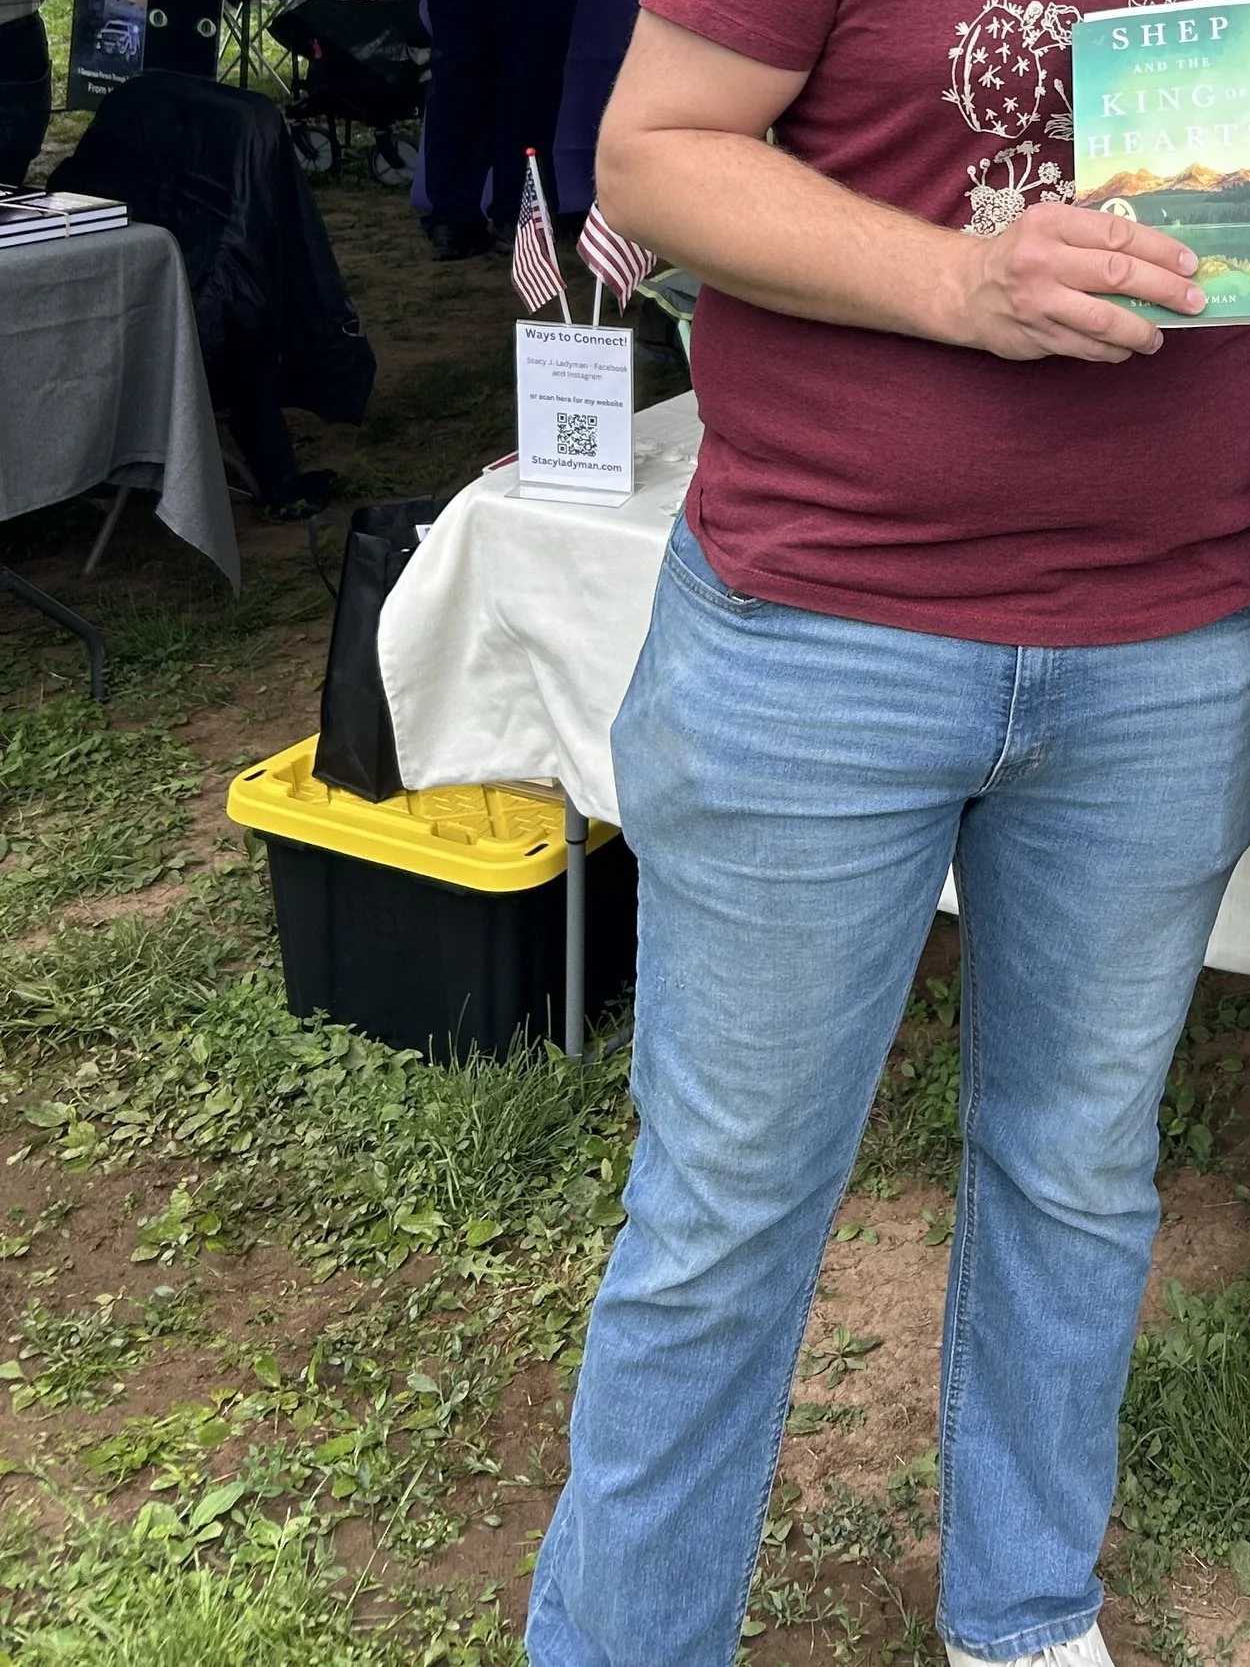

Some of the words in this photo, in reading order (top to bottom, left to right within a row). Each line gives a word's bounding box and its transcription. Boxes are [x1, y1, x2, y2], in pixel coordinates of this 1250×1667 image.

[1112, 16, 1228, 50] SHEP
[1132, 61, 1168, 74] AND
[1176, 57, 1210, 70] THE
[1101, 84, 1216, 118] KING
[1225, 87, 1248, 100] OF
[1204, 294, 1236, 304] YMAN
[525, 328, 556, 342] Ways
[558, 332, 571, 342] to
[574, 333, 628, 346] Connect!
[526, 356, 547, 366] Stacy
[556, 359, 588, 369] Ladyman
[594, 362, 628, 372] Facebook
[567, 371, 602, 381] Instagram
[572, 396, 583, 404] for
[584, 398, 595, 406] my
[596, 398, 624, 408] website
[532, 455, 622, 472] Stacyladyman.com
